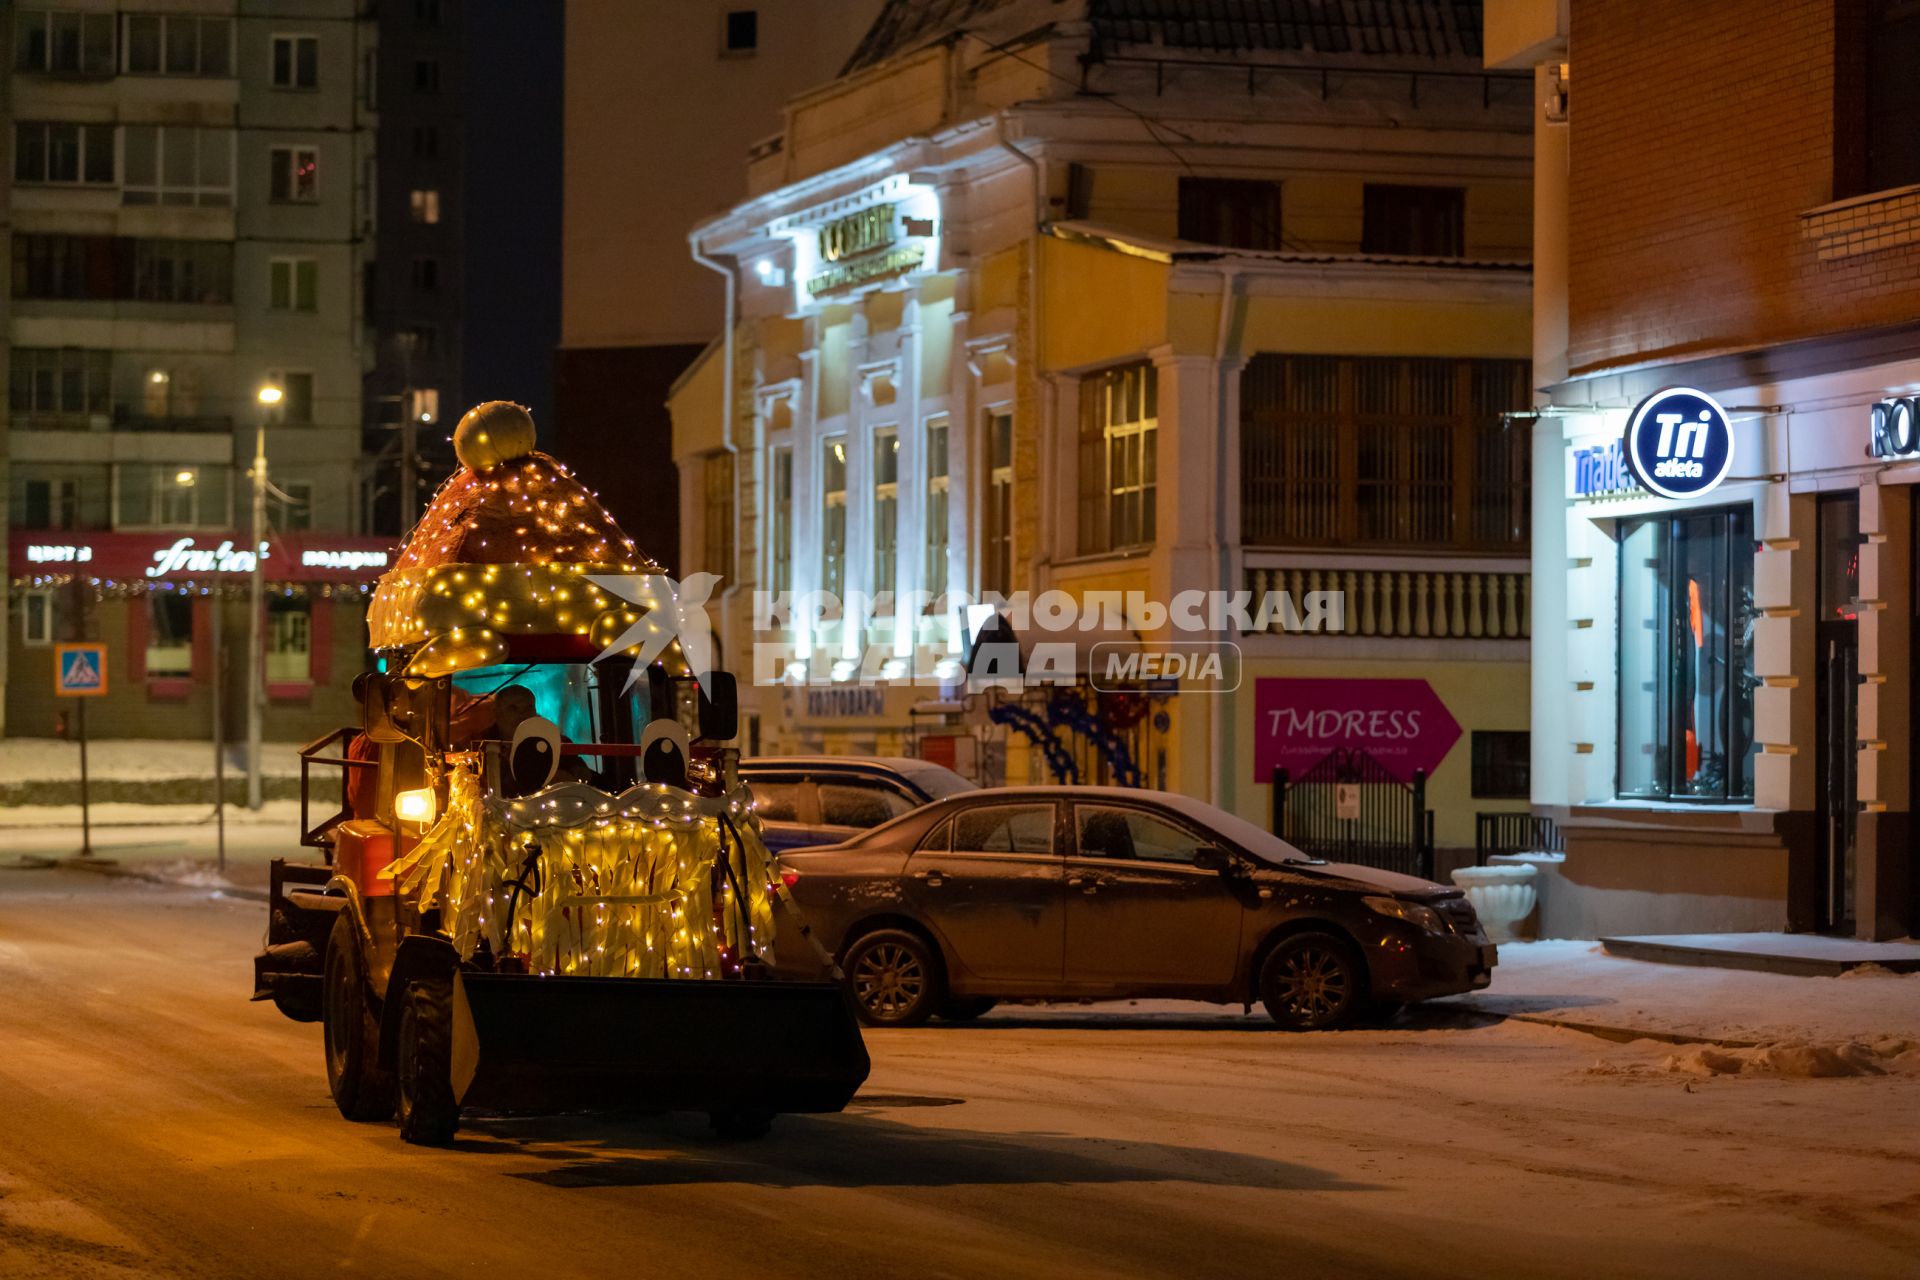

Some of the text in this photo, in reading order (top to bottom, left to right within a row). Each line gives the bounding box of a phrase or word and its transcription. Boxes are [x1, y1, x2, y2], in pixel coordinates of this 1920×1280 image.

[1656, 410, 1711, 458] Tri
[1574, 437, 1637, 494] Triatle
[1654, 458, 1703, 478] atleta
[1268, 708, 1421, 739] TMDRESS
